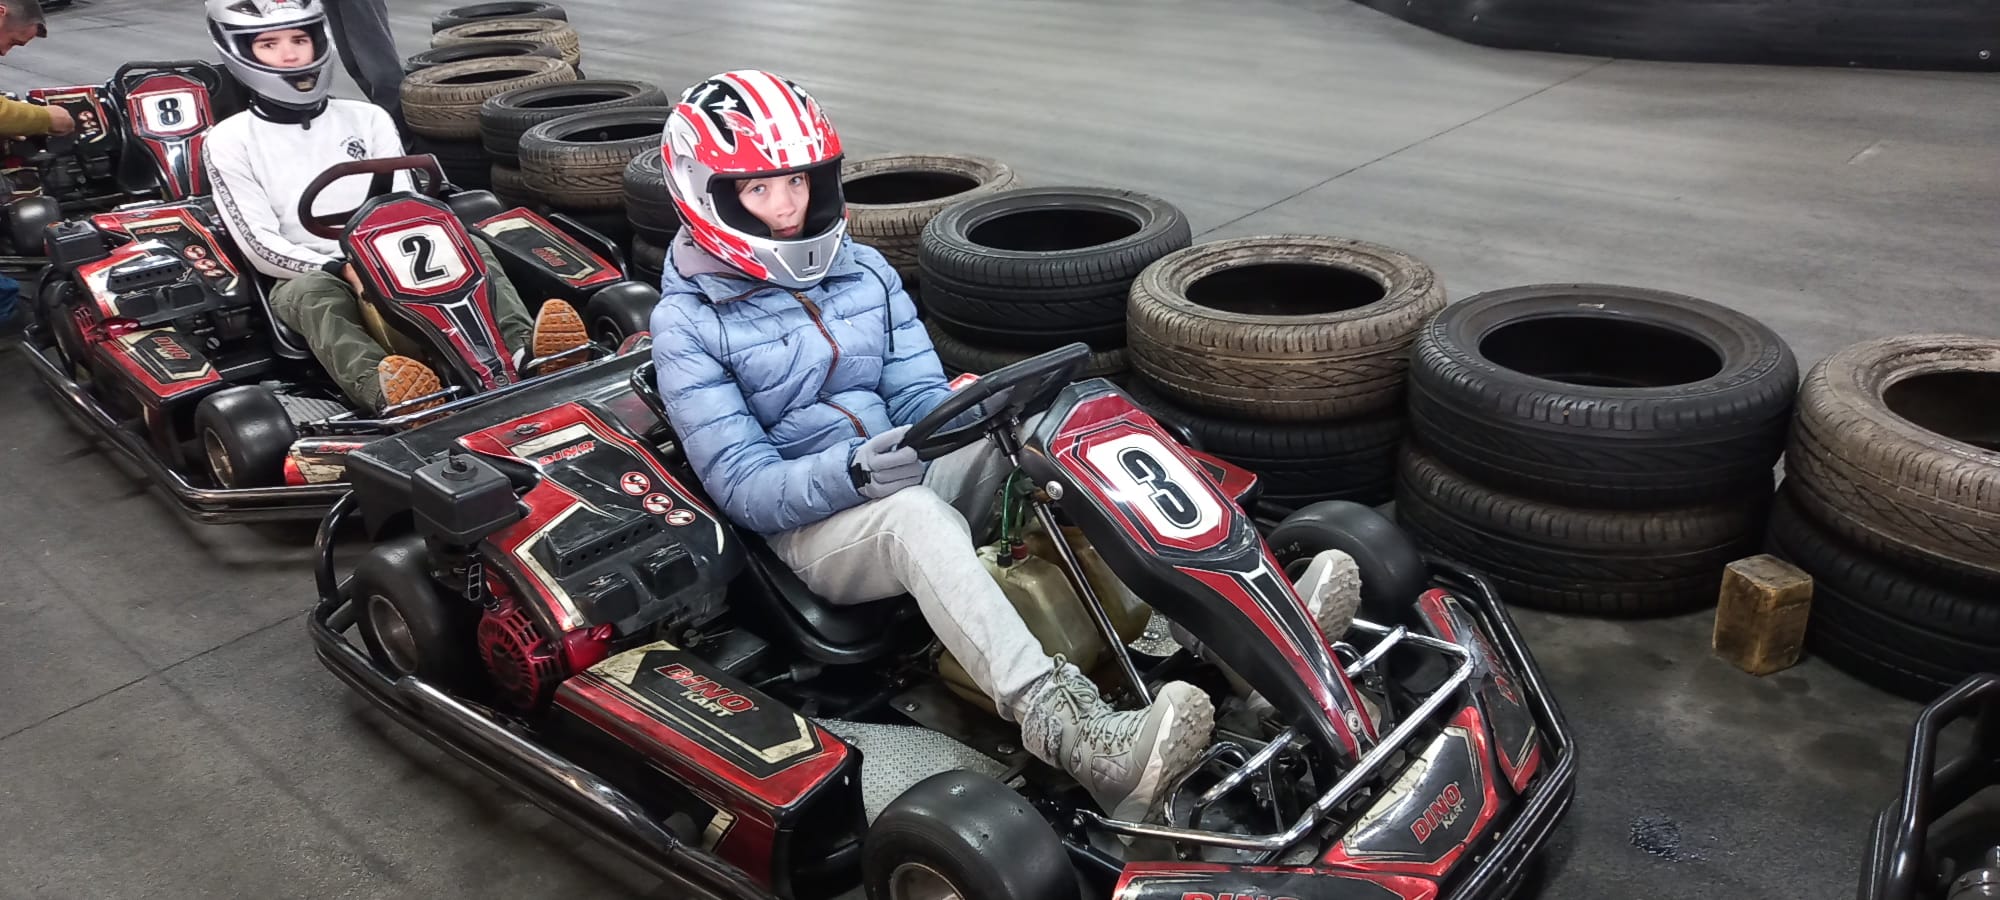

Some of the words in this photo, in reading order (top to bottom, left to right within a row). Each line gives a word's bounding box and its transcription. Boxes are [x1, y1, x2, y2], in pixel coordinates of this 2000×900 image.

[156, 97, 184, 128] 8
[398, 233, 450, 285] 2
[537, 441, 595, 465] DINO
[1117, 447, 1202, 530] 3
[653, 663, 755, 712] DINO
[680, 690, 734, 717] KART
[1410, 783, 1461, 844] DINO
